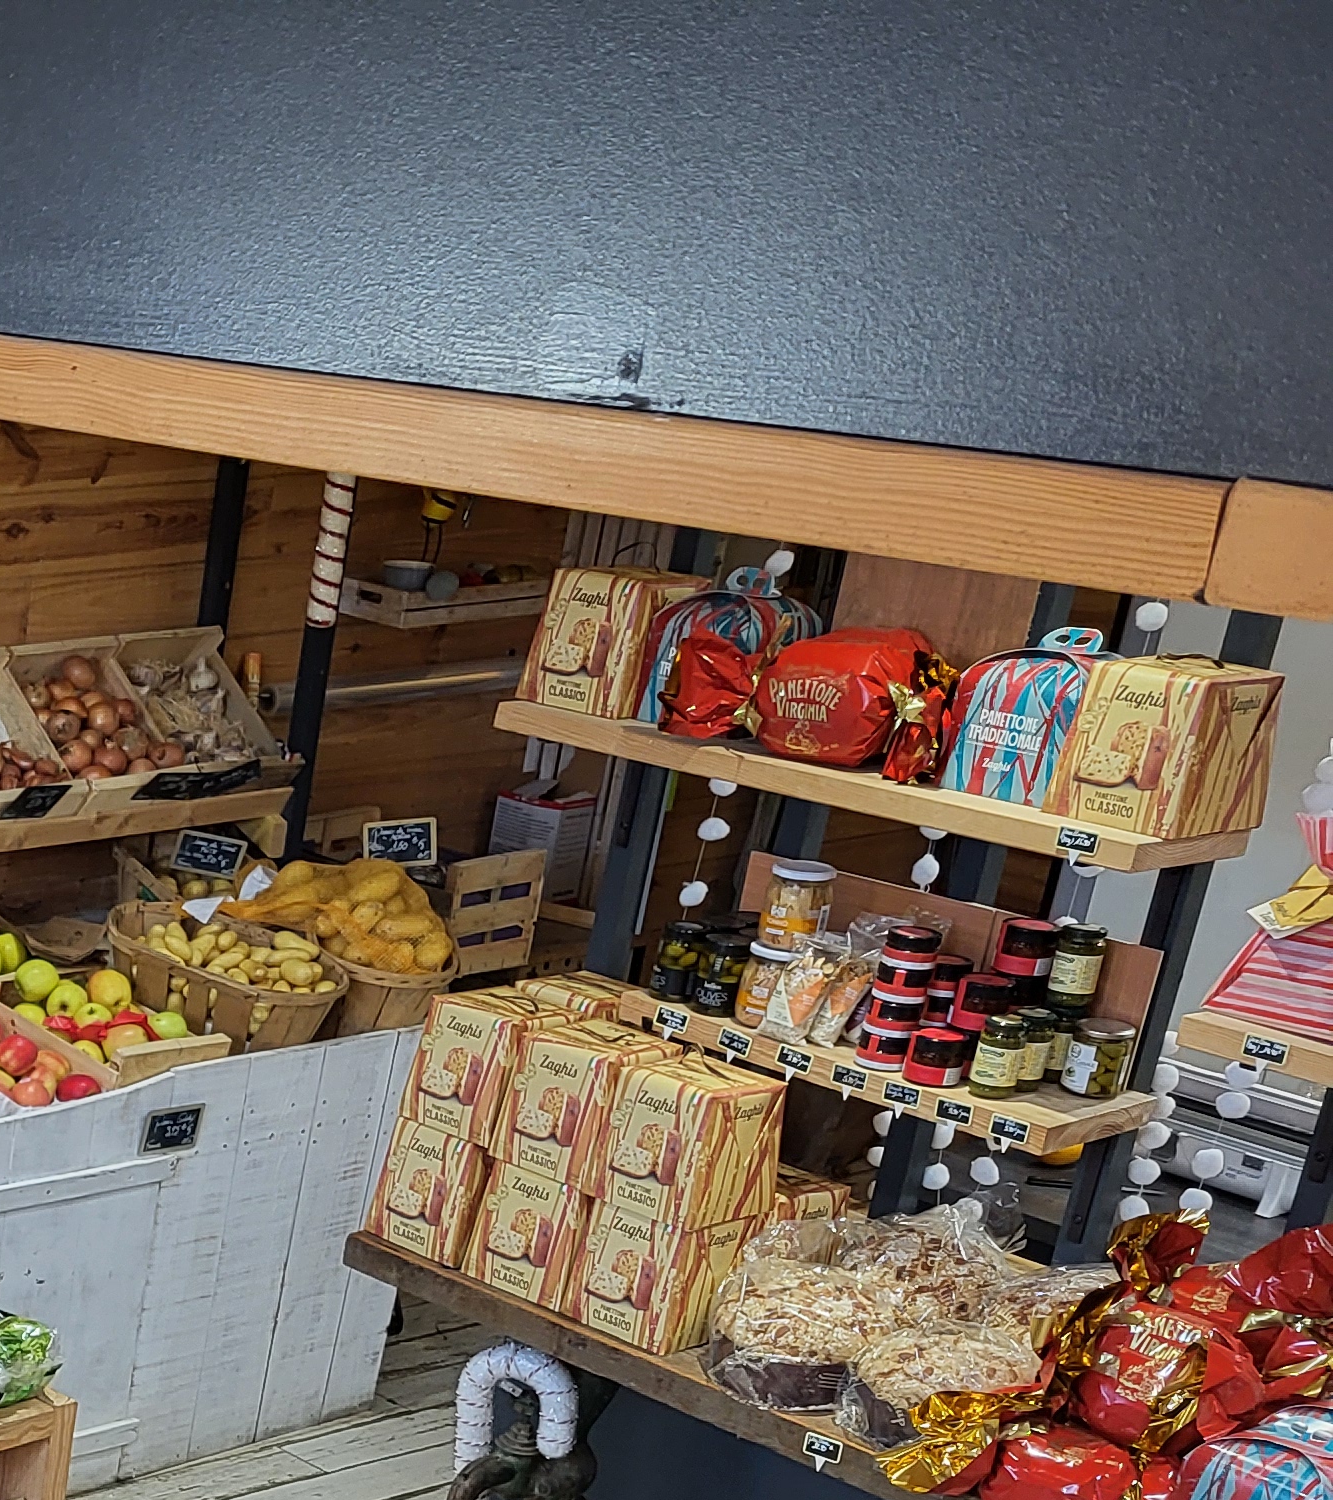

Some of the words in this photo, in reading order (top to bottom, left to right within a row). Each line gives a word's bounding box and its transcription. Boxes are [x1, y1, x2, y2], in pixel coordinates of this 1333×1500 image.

[548, 684, 586, 702] CLASSICO
[1115, 683, 1167, 708] Zaghis
[980, 709, 1039, 735] PANETTONE
[968, 724, 1042, 752] TRADIZIONALE
[1085, 797, 1133, 819] CLASSICO
[446, 1015, 483, 1040] Zaghis
[539, 1054, 578, 1078] Zaghis
[636, 1089, 677, 1115] Zaghis
[425, 1108, 459, 1129] CLASSICO
[520, 1150, 557, 1171] CLASSICO
[512, 1177, 549, 1201] Zaghis
[617, 1186, 656, 1208] CLASSICO
[393, 1225, 425, 1247] CLASSICO
[612, 1216, 653, 1242] Zaghis
[493, 1268, 529, 1291] CLASSICO
[593, 1308, 631, 1332] CLASSICO
